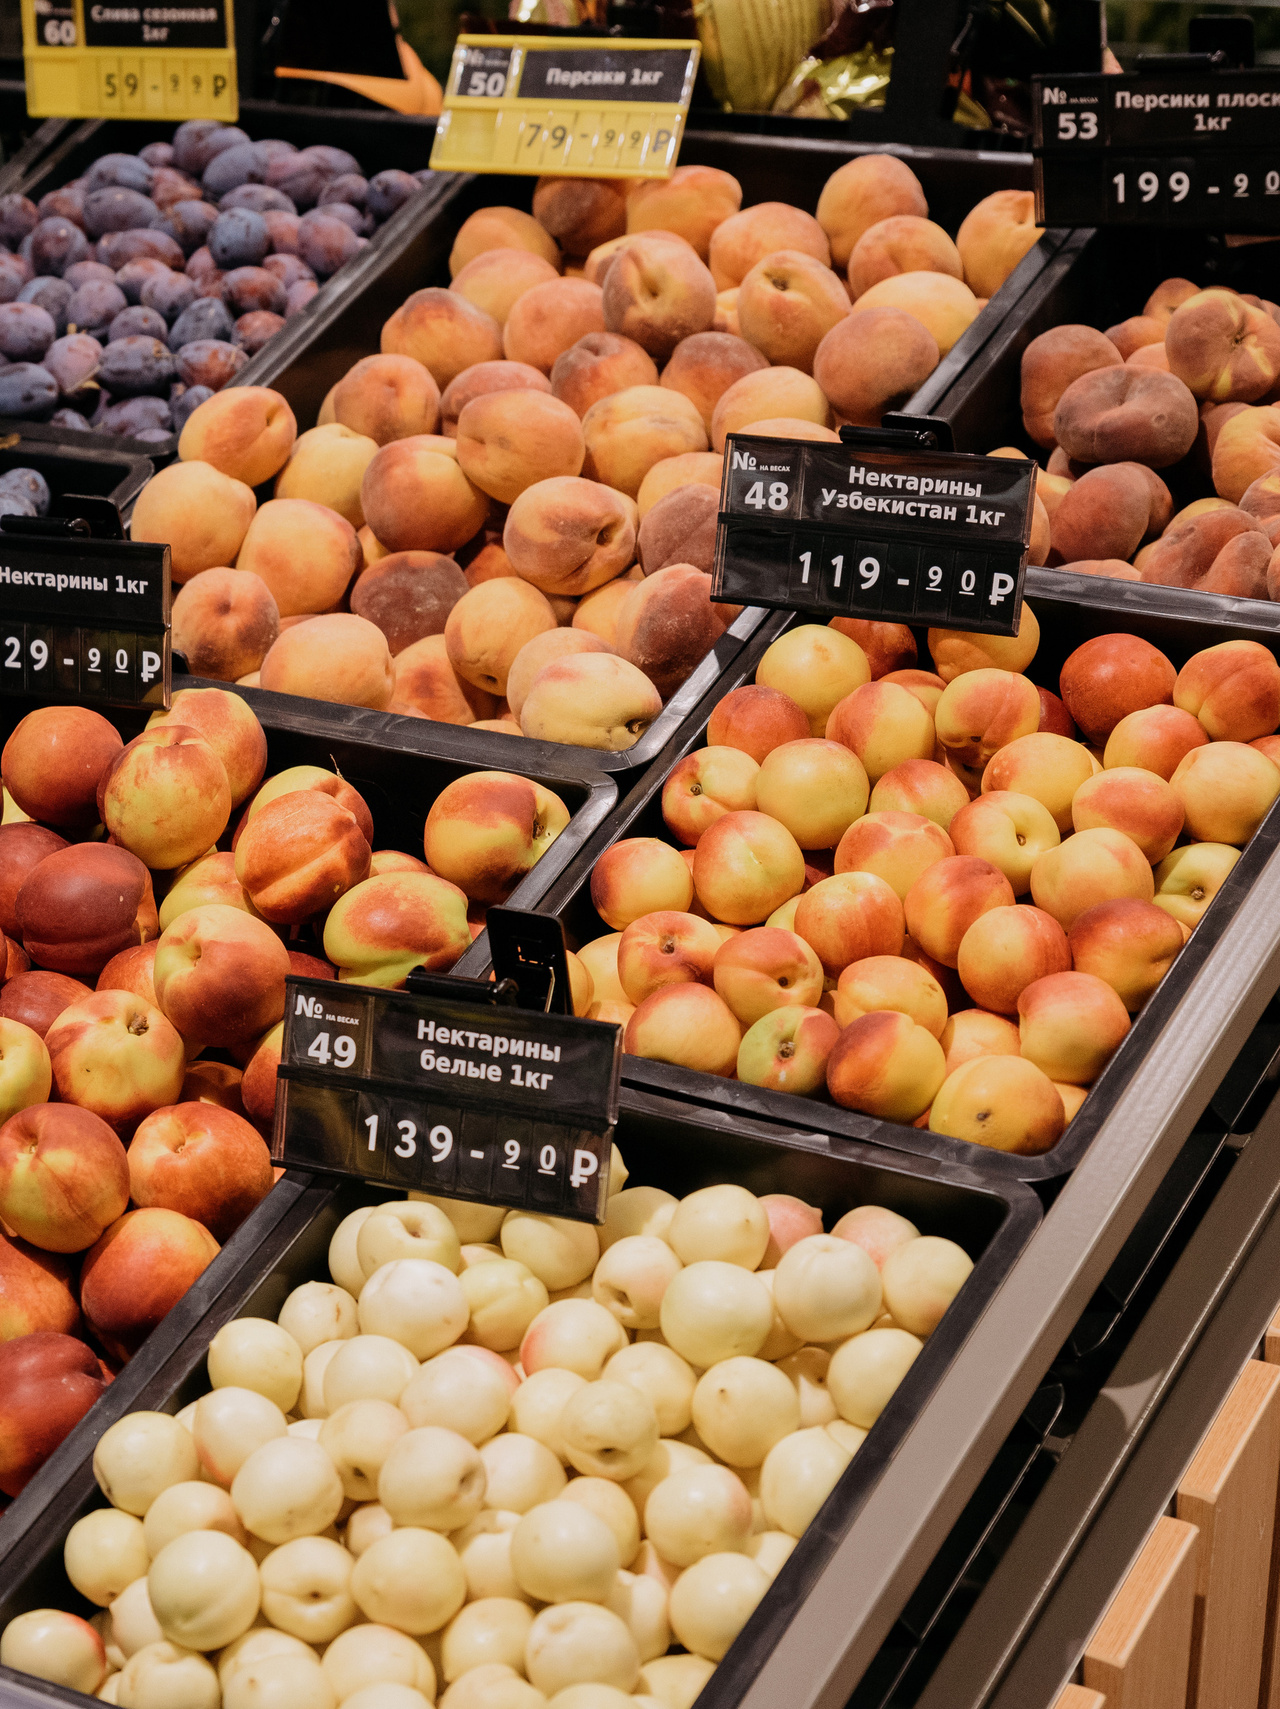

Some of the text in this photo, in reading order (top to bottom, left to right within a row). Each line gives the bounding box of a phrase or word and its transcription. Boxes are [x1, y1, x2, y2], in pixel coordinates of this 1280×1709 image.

[44, 19, 76, 45] 60
[468, 72, 506, 97] 50
[546, 67, 664, 88] Персики 1кг
[1115, 91, 1210, 112] Персики
[1058, 112, 1098, 140] 53
[1193, 113, 1232, 131] 1кг
[732, 452, 757, 470] №
[744, 481, 789, 511] 48
[849, 466, 982, 498] Нектарины
[821, 488, 1006, 526] Узбекистан 1кг
[115, 575, 149, 594] 1кг
[295, 994, 359, 1025] № НА ВЕСАХ
[307, 1031, 357, 1068] 49
[417, 1019, 561, 1063] Нектарины
[420, 1049, 554, 1090] белые 1кг
